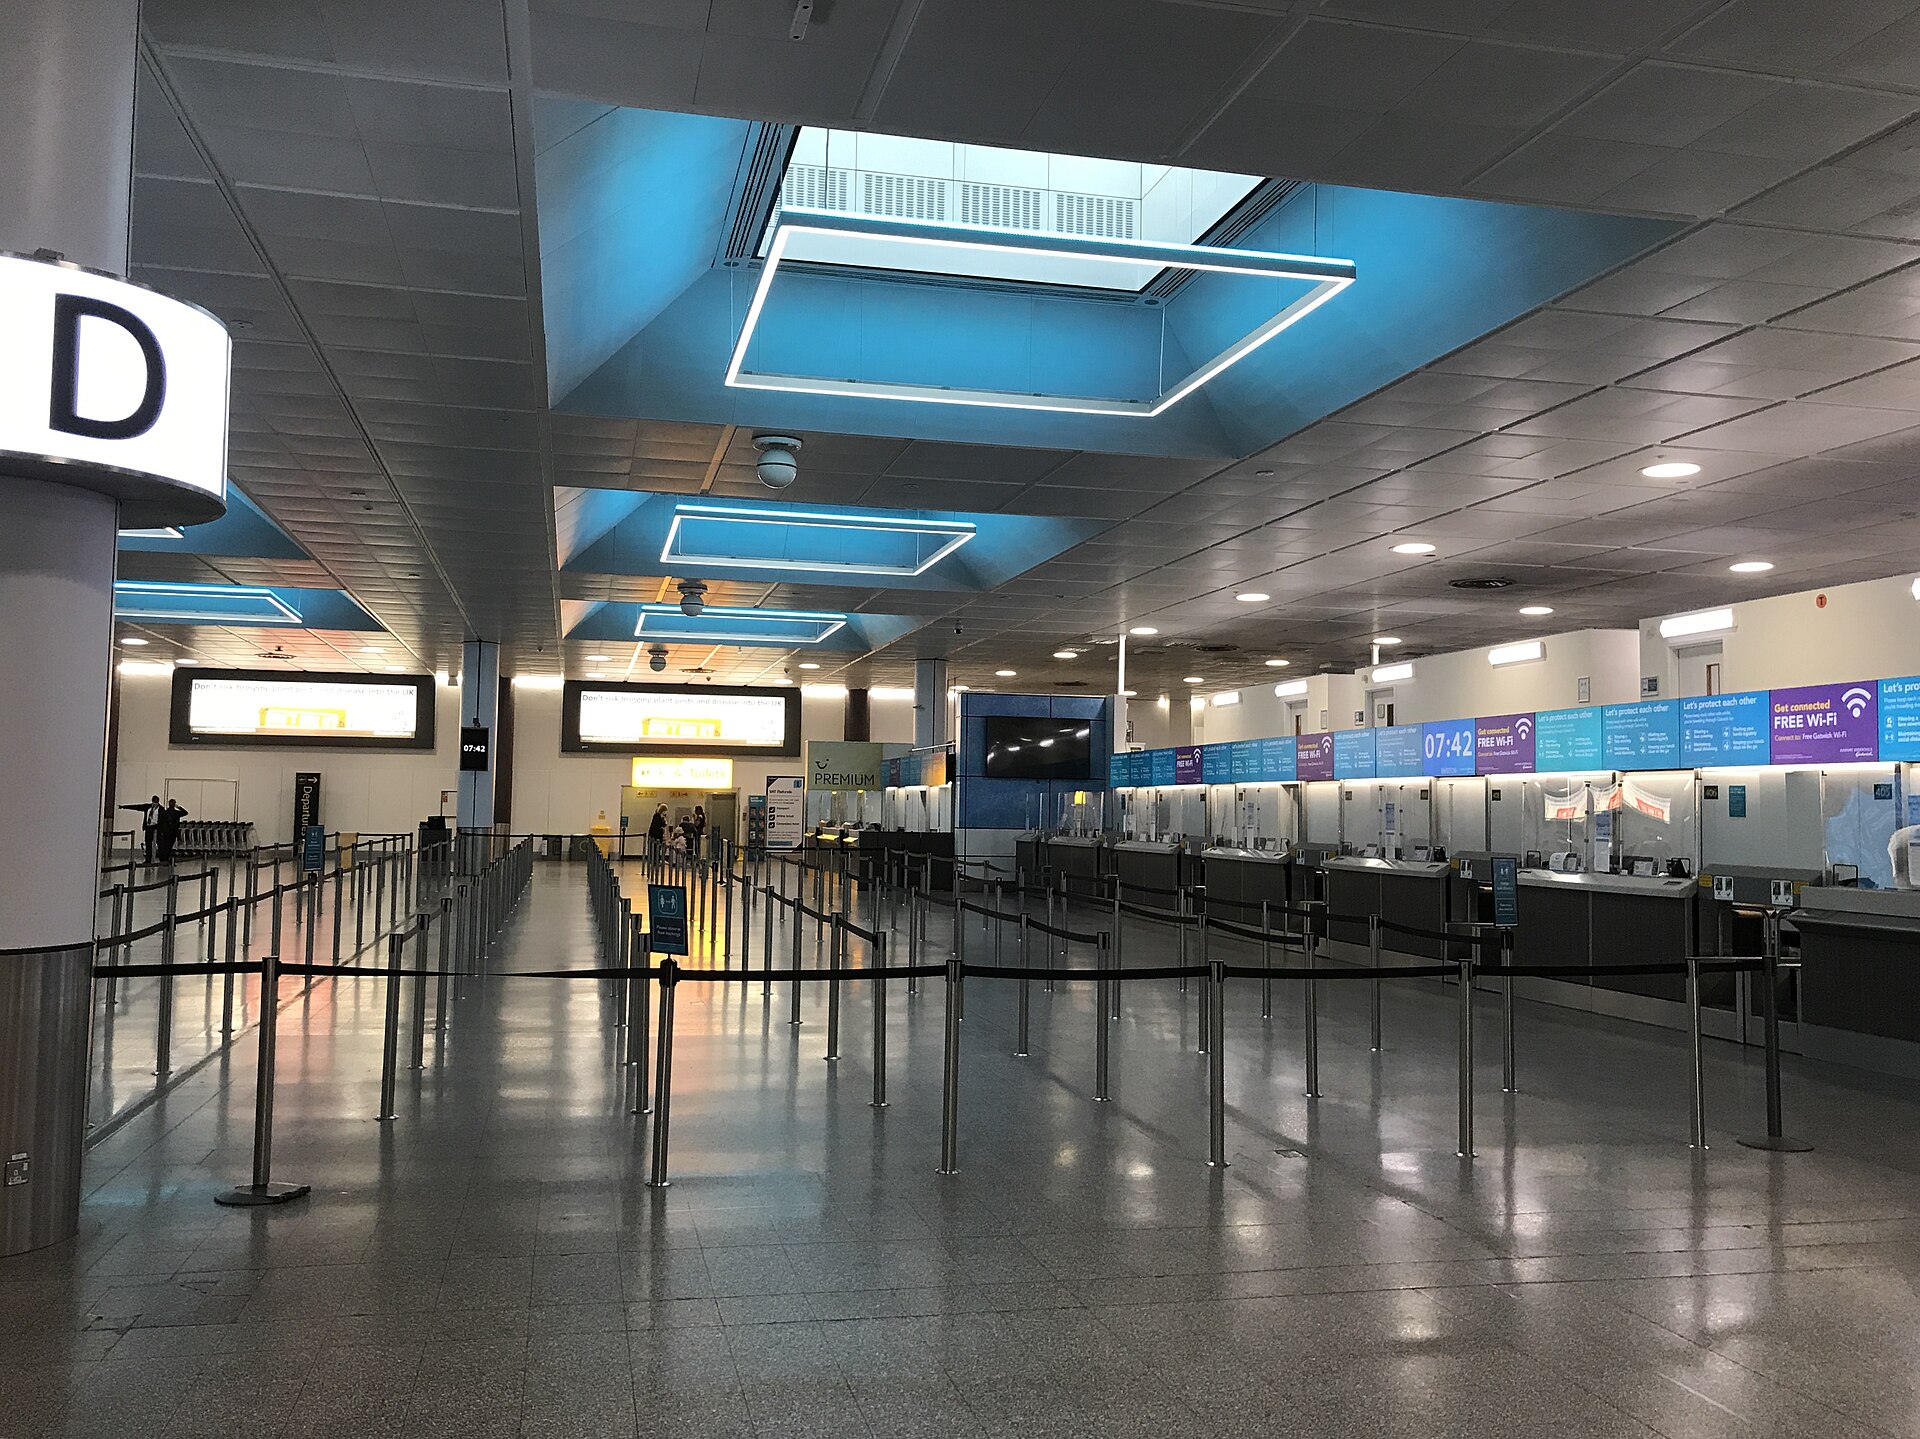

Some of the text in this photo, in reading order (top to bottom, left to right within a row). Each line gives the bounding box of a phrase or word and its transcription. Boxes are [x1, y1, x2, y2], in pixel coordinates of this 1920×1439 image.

[49, 293, 167, 440] D
[194, 682, 217, 690] Don't
[1883, 682, 1902, 693] Let's
[582, 694, 603, 702] Don't
[1683, 695, 1757, 710] Let's protect each other
[1605, 704, 1669, 718] Let's protect each other
[1774, 699, 1831, 713] Get connected
[1774, 712, 1837, 729] FREE Wi-Fi
[1477, 726, 1509, 736] Get connected
[1813, 732, 1833, 740] Gatwick
[1834, 730, 1847, 738] Wi-Fi
[1425, 731, 1472, 759] 07:42
[1477, 735, 1513, 748] FREE Wi-Fi
[463, 744, 486, 752] 07:42
[1298, 750, 1321, 760] FREE Wi-Fi
[814, 773, 875, 785] PREMIUM
